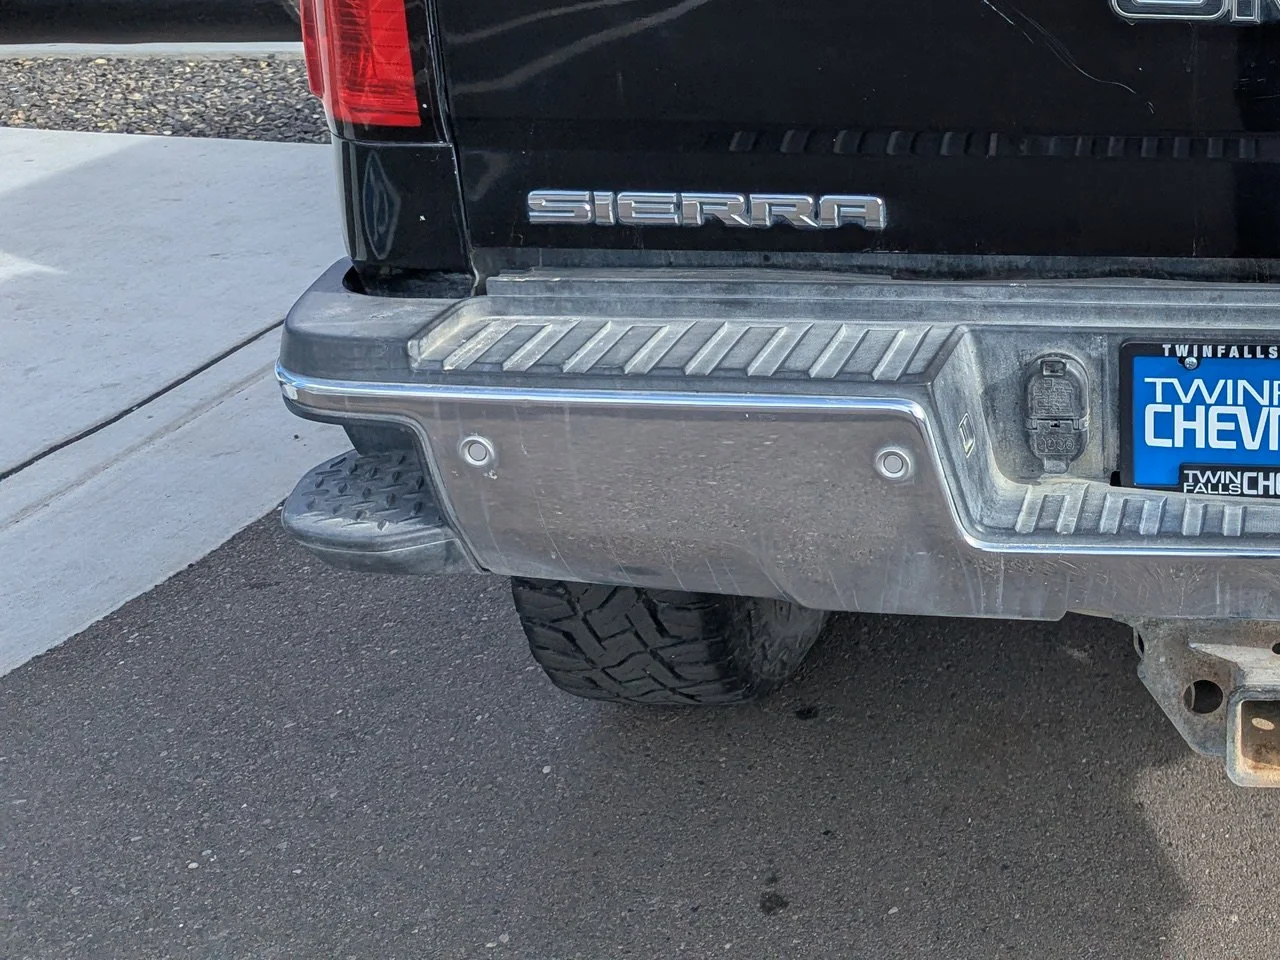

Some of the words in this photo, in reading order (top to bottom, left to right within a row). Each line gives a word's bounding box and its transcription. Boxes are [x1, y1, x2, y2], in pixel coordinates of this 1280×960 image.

[527, 190, 887, 230] SIERRA
[1183, 470, 1241, 484] TWIN
[1183, 482, 1242, 495] FALLS
